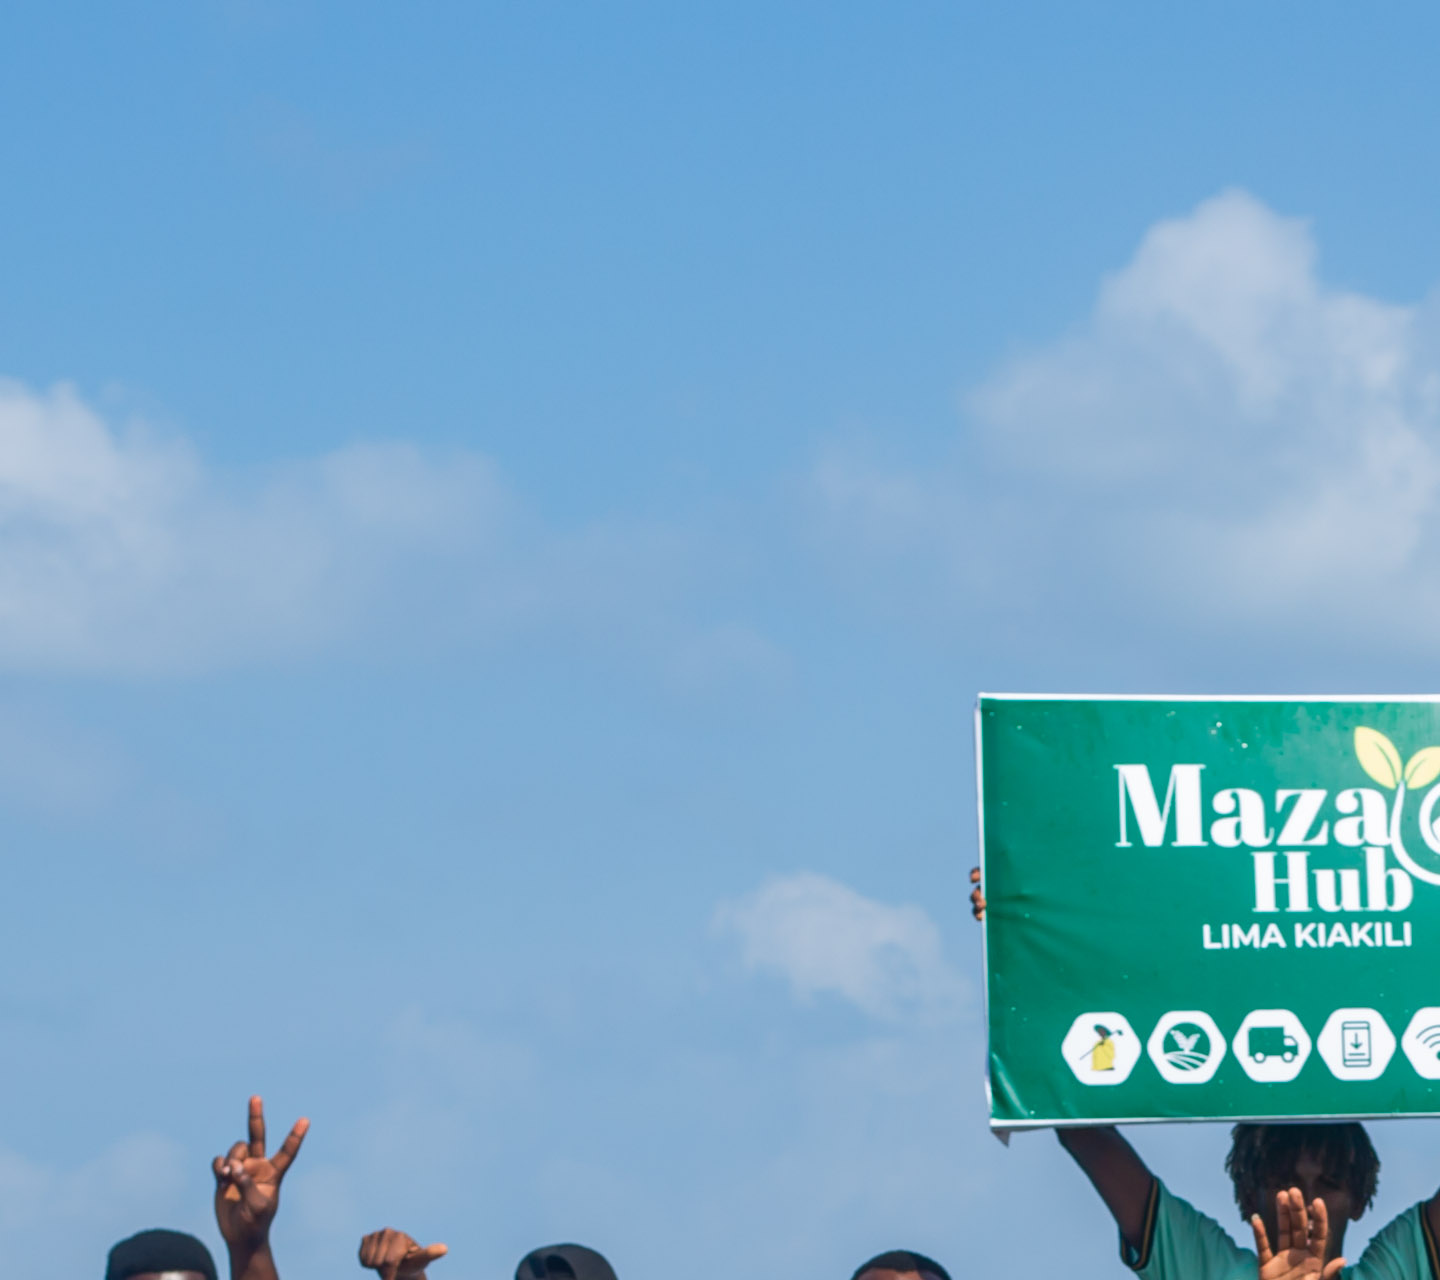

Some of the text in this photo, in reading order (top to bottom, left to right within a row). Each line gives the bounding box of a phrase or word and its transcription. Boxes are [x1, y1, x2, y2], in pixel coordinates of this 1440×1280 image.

[1113, 764, 1394, 848] Maza
[1252, 846, 1414, 913] Hub
[1202, 921, 1412, 950] LIMA KIAKILI
